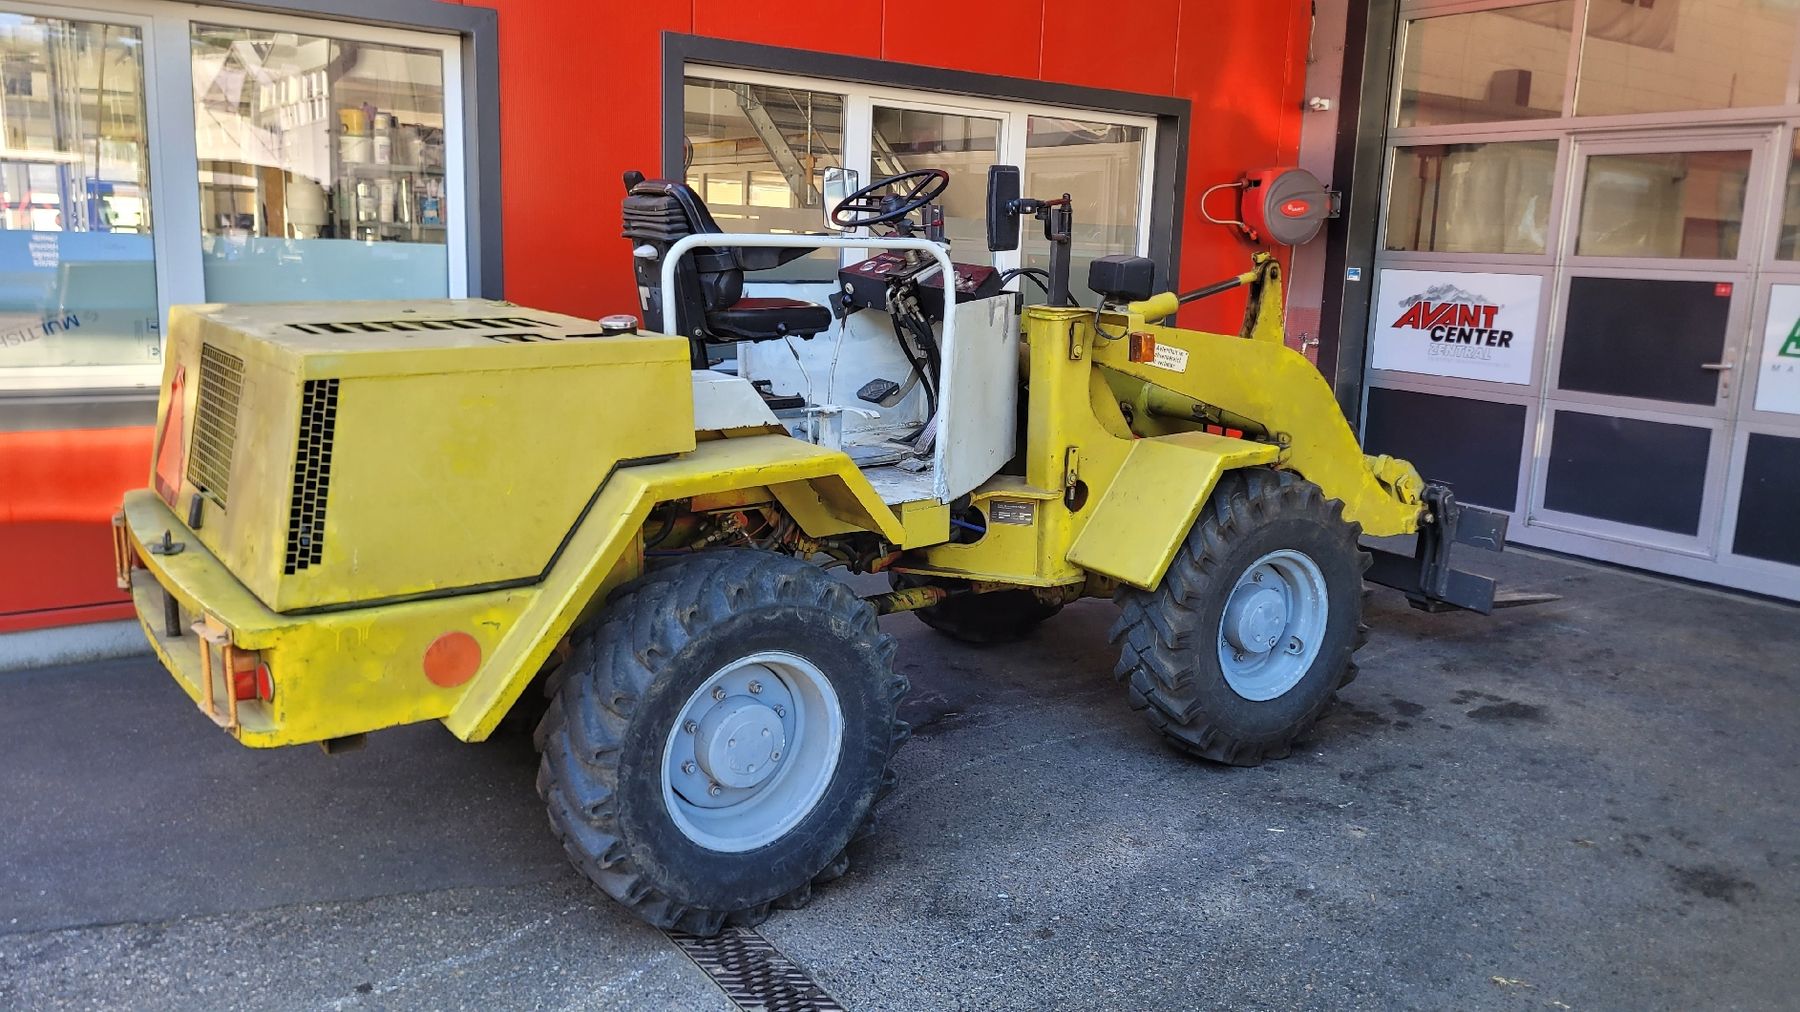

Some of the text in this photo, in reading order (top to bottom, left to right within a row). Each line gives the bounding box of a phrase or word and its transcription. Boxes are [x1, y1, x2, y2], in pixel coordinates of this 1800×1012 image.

[1391, 301, 1499, 331] AVANT
[1430, 326, 1514, 348] CENTER
[1428, 342, 1492, 361] ZENTRAL
